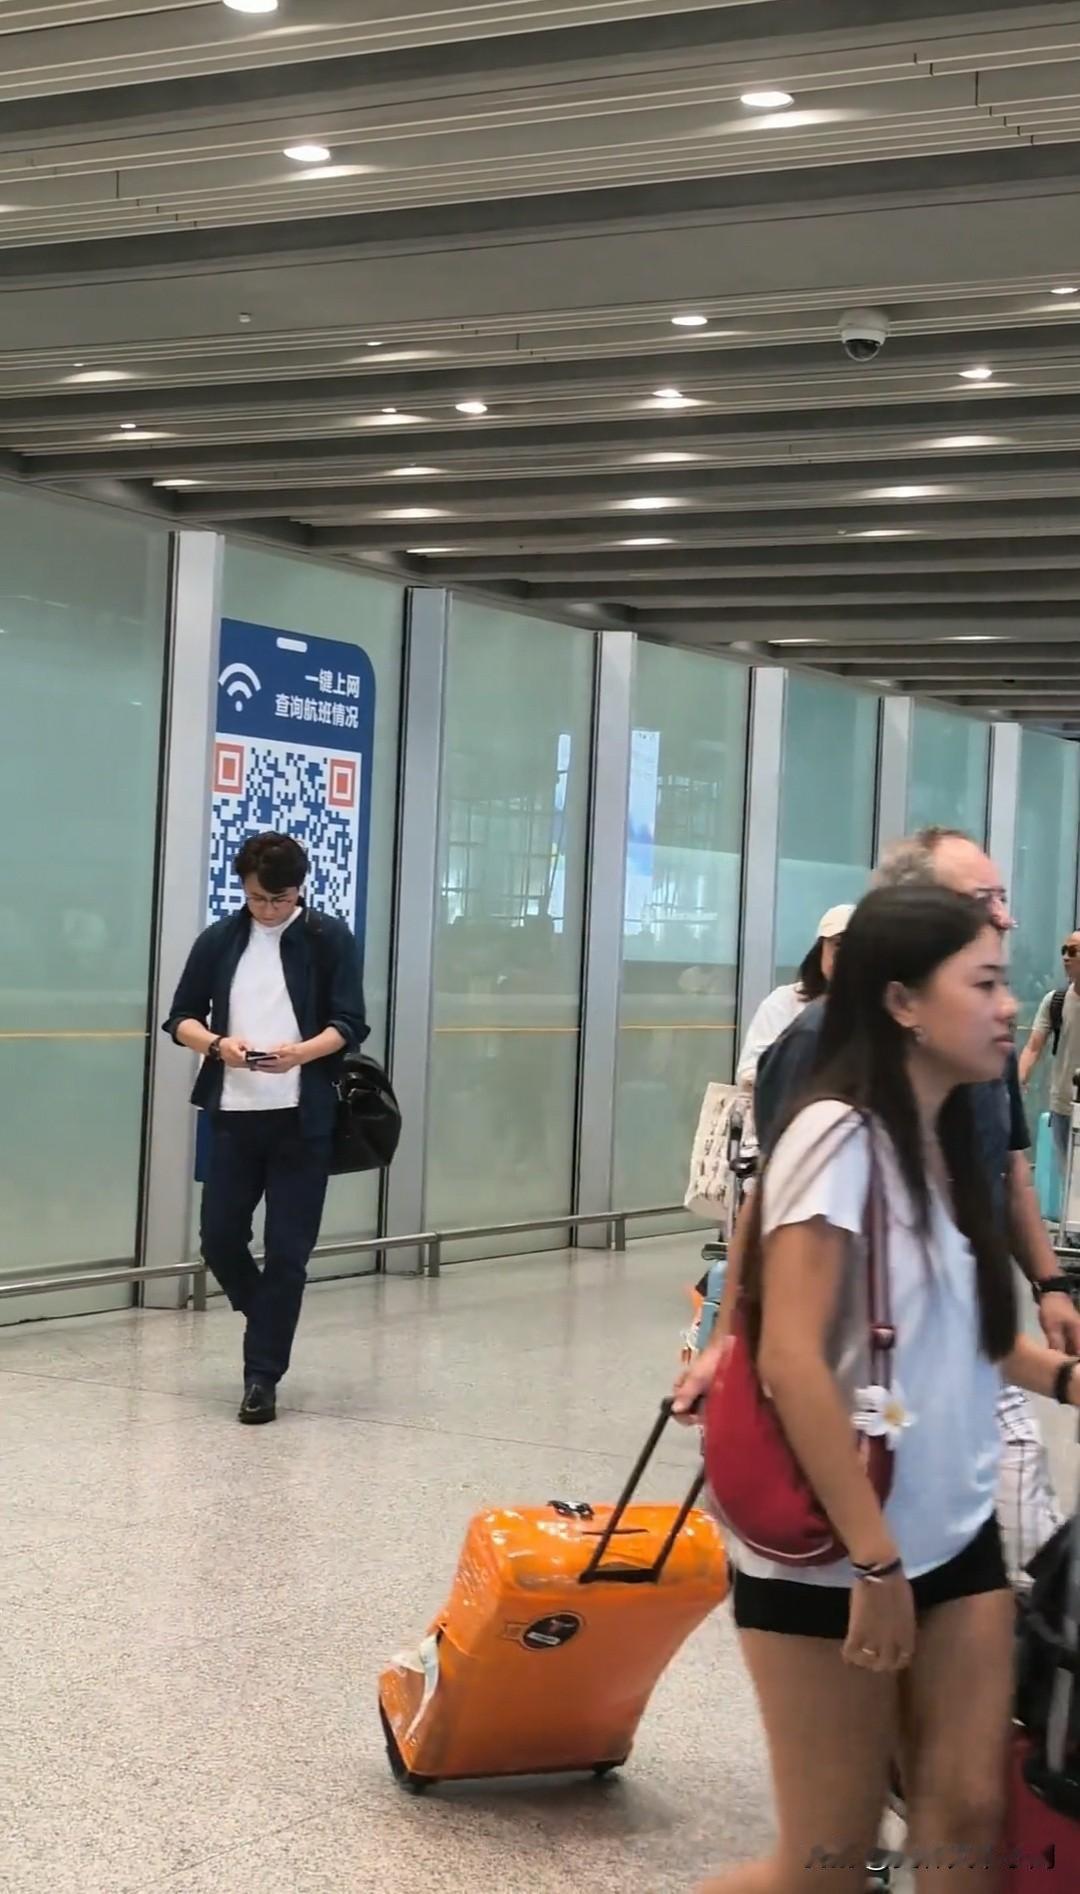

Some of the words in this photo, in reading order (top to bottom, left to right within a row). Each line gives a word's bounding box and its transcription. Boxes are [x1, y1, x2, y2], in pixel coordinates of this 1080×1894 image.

[304, 668, 360, 698] 一键上网
[275, 693, 359, 728] 查询航班情况
